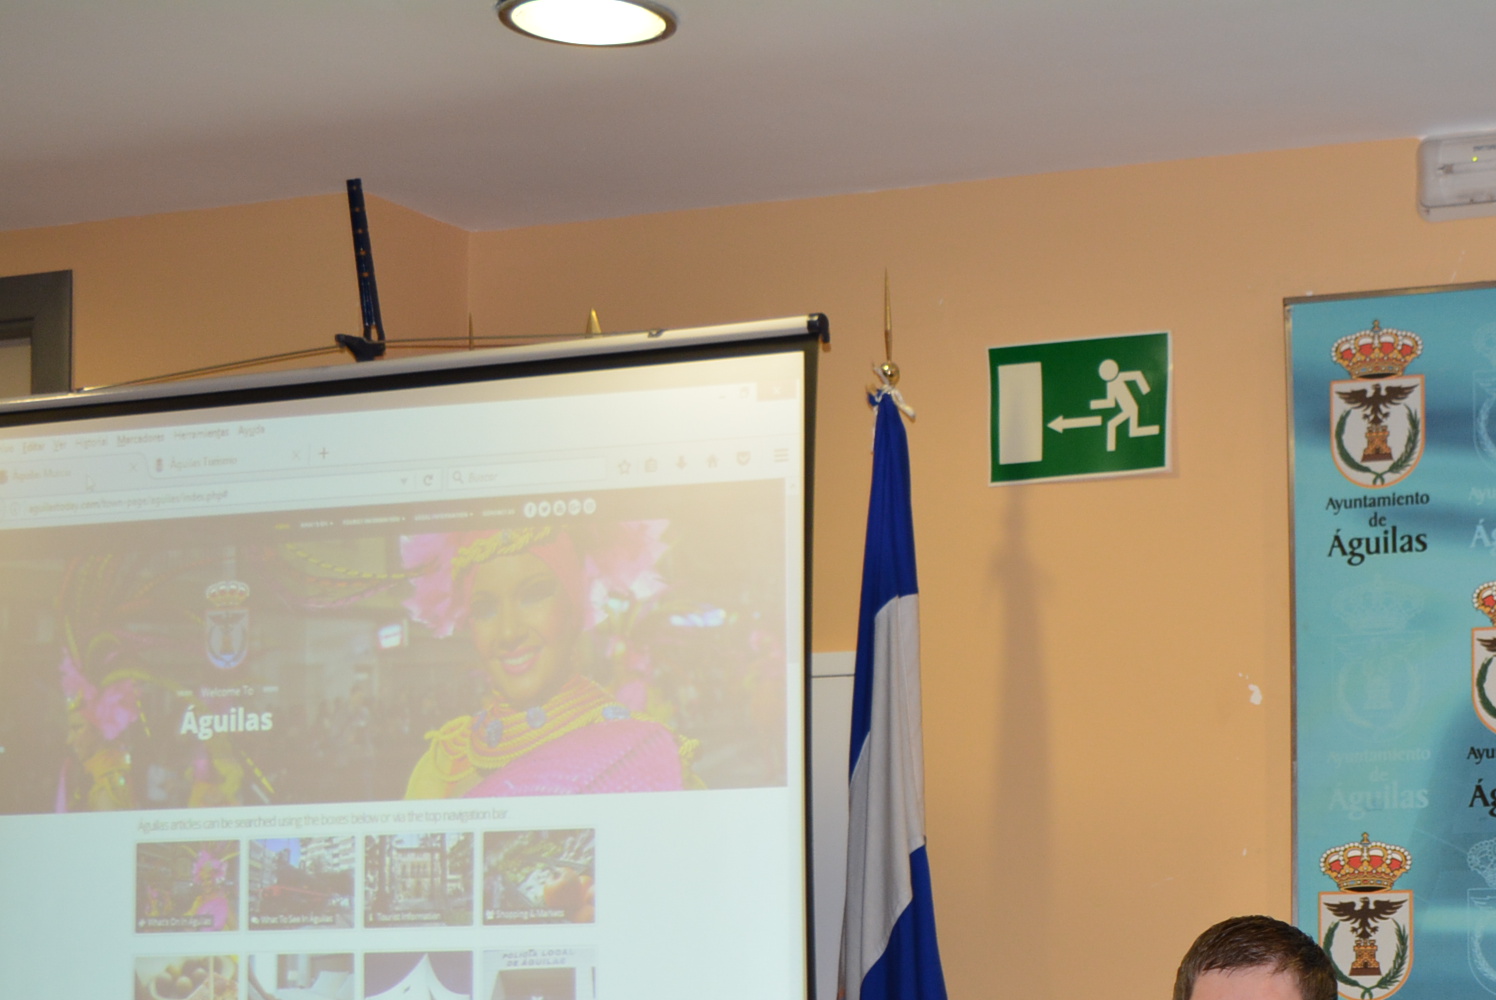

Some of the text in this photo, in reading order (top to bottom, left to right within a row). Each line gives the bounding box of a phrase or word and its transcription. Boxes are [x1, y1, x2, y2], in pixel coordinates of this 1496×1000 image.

[1326, 491, 1430, 515] Ayuntamiento
[1368, 511, 1388, 528] de
[1327, 525, 1429, 568] Águilas
[201, 685, 255, 698] Welcome To
[181, 704, 274, 740] Águilas
